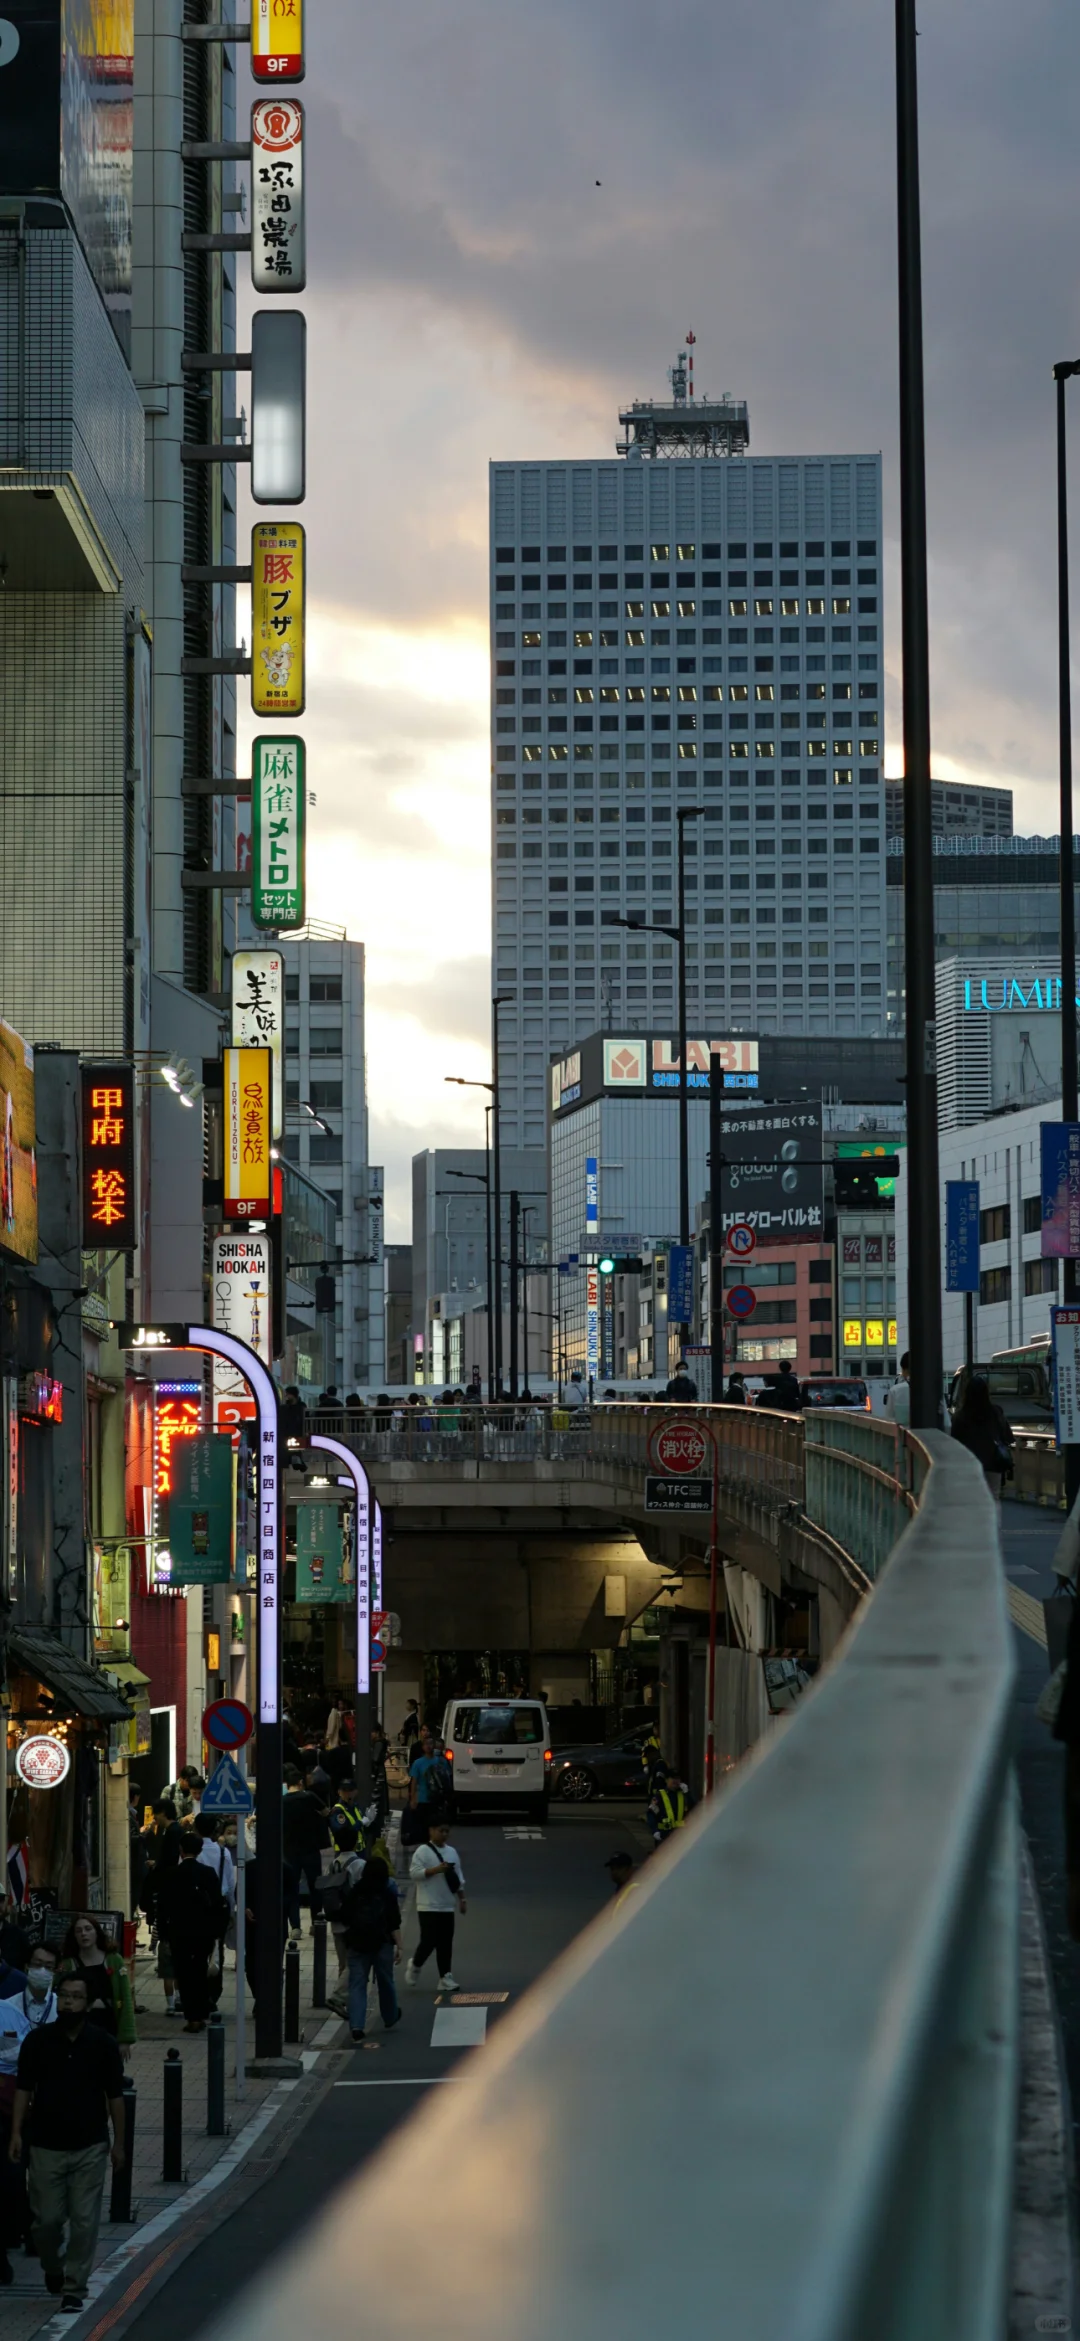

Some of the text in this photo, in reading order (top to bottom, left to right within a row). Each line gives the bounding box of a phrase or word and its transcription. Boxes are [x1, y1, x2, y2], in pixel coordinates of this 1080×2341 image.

[267, 58, 288, 72] 9F
[258, 161, 295, 276] 塚田農場
[263, 749, 294, 885] 麻雀メトロ
[261, 892, 296, 906] セット
[260, 907, 297, 920] 専門店
[964, 977, 1080, 1012] LUMI
[652, 1039, 759, 1072] LABI
[720, 1114, 820, 1134] 来の不動産を面白くする。
[91, 1088, 125, 1225] 甲府 松本
[237, 1201, 257, 1215] 9F
[218, 1243, 263, 1257] SHISHA
[216, 1260, 266, 1274] HOOKAH
[587, 1274, 598, 1305] LABI
[587, 1311, 598, 1358] SHINJUKU
[662, 1439, 702, 1458] 消火栓
[667, 1485, 689, 1496] TFC
[262, 1431, 275, 1608] 新宿四丁目商店会
